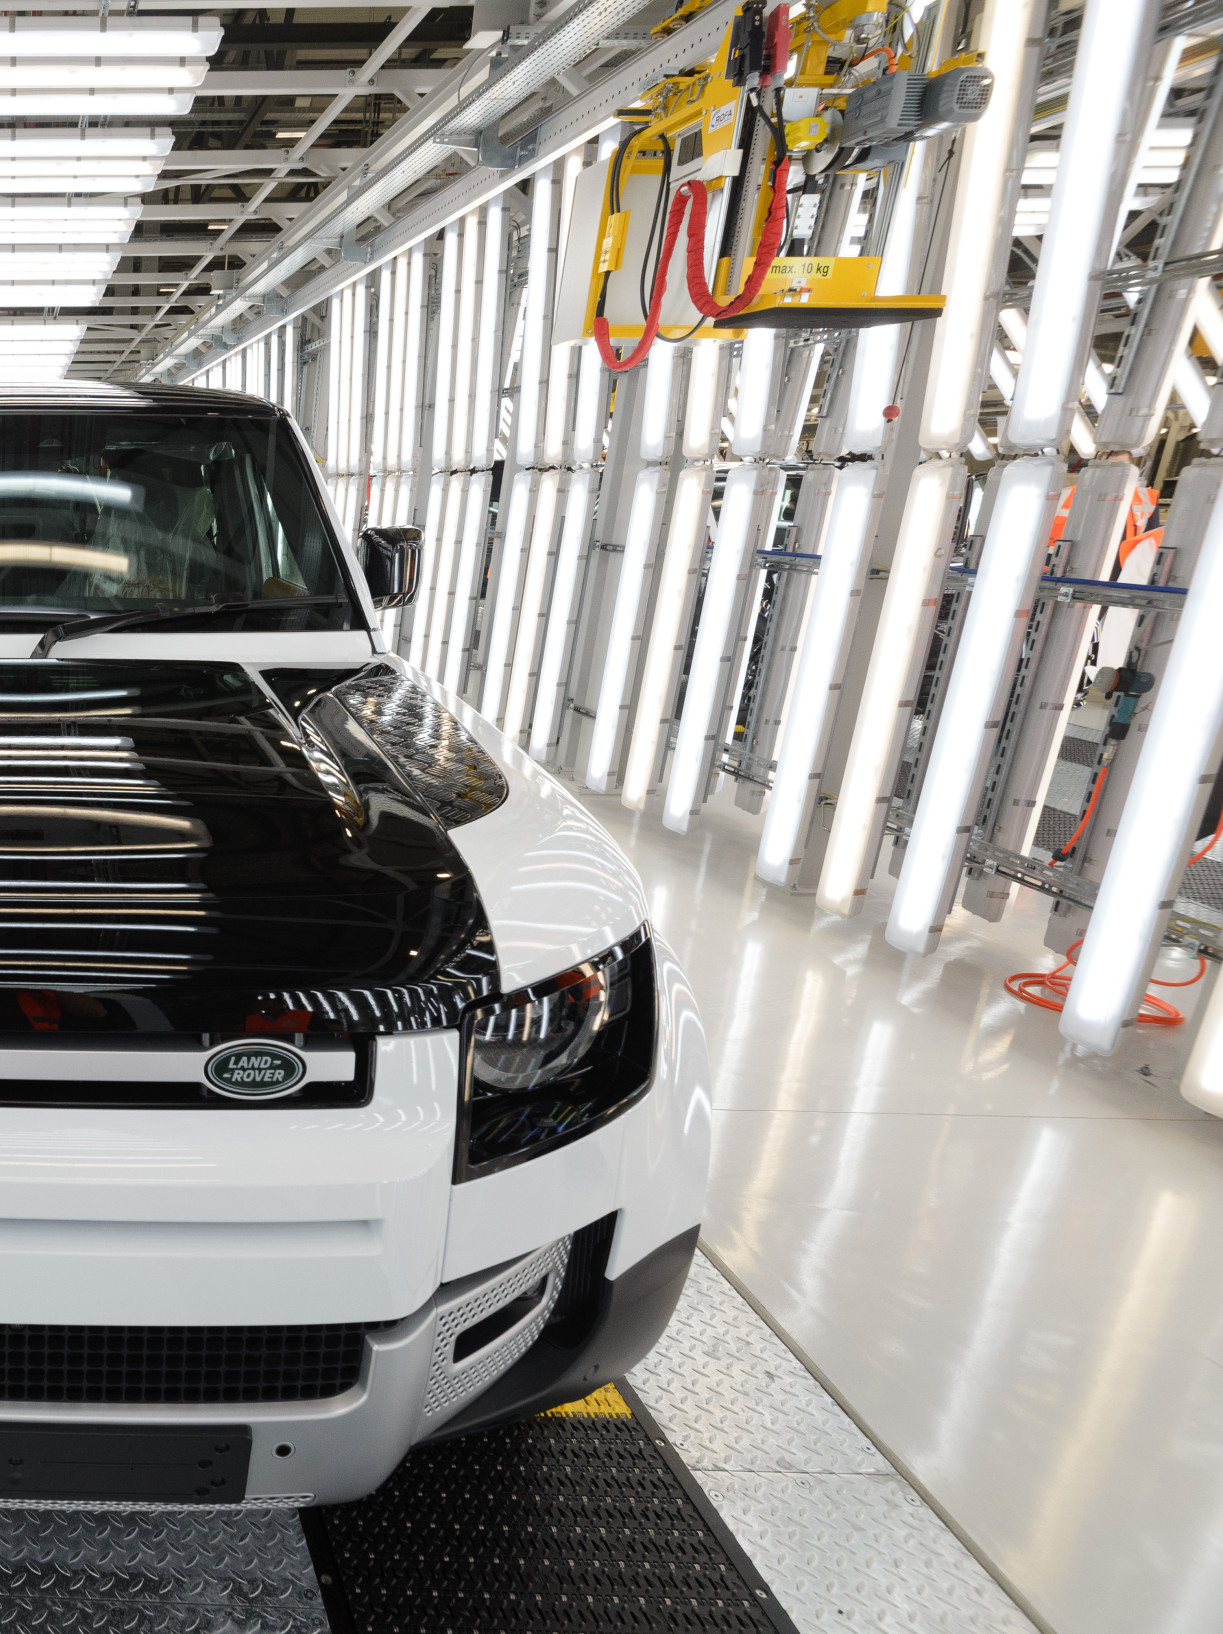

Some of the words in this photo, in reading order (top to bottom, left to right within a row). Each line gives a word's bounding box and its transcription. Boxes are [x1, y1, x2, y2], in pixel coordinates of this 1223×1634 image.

[715, 109, 732, 124] ROFA
[770, 265, 796, 274] max.
[801, 263, 813, 274] 10
[816, 263, 830, 277] kg
